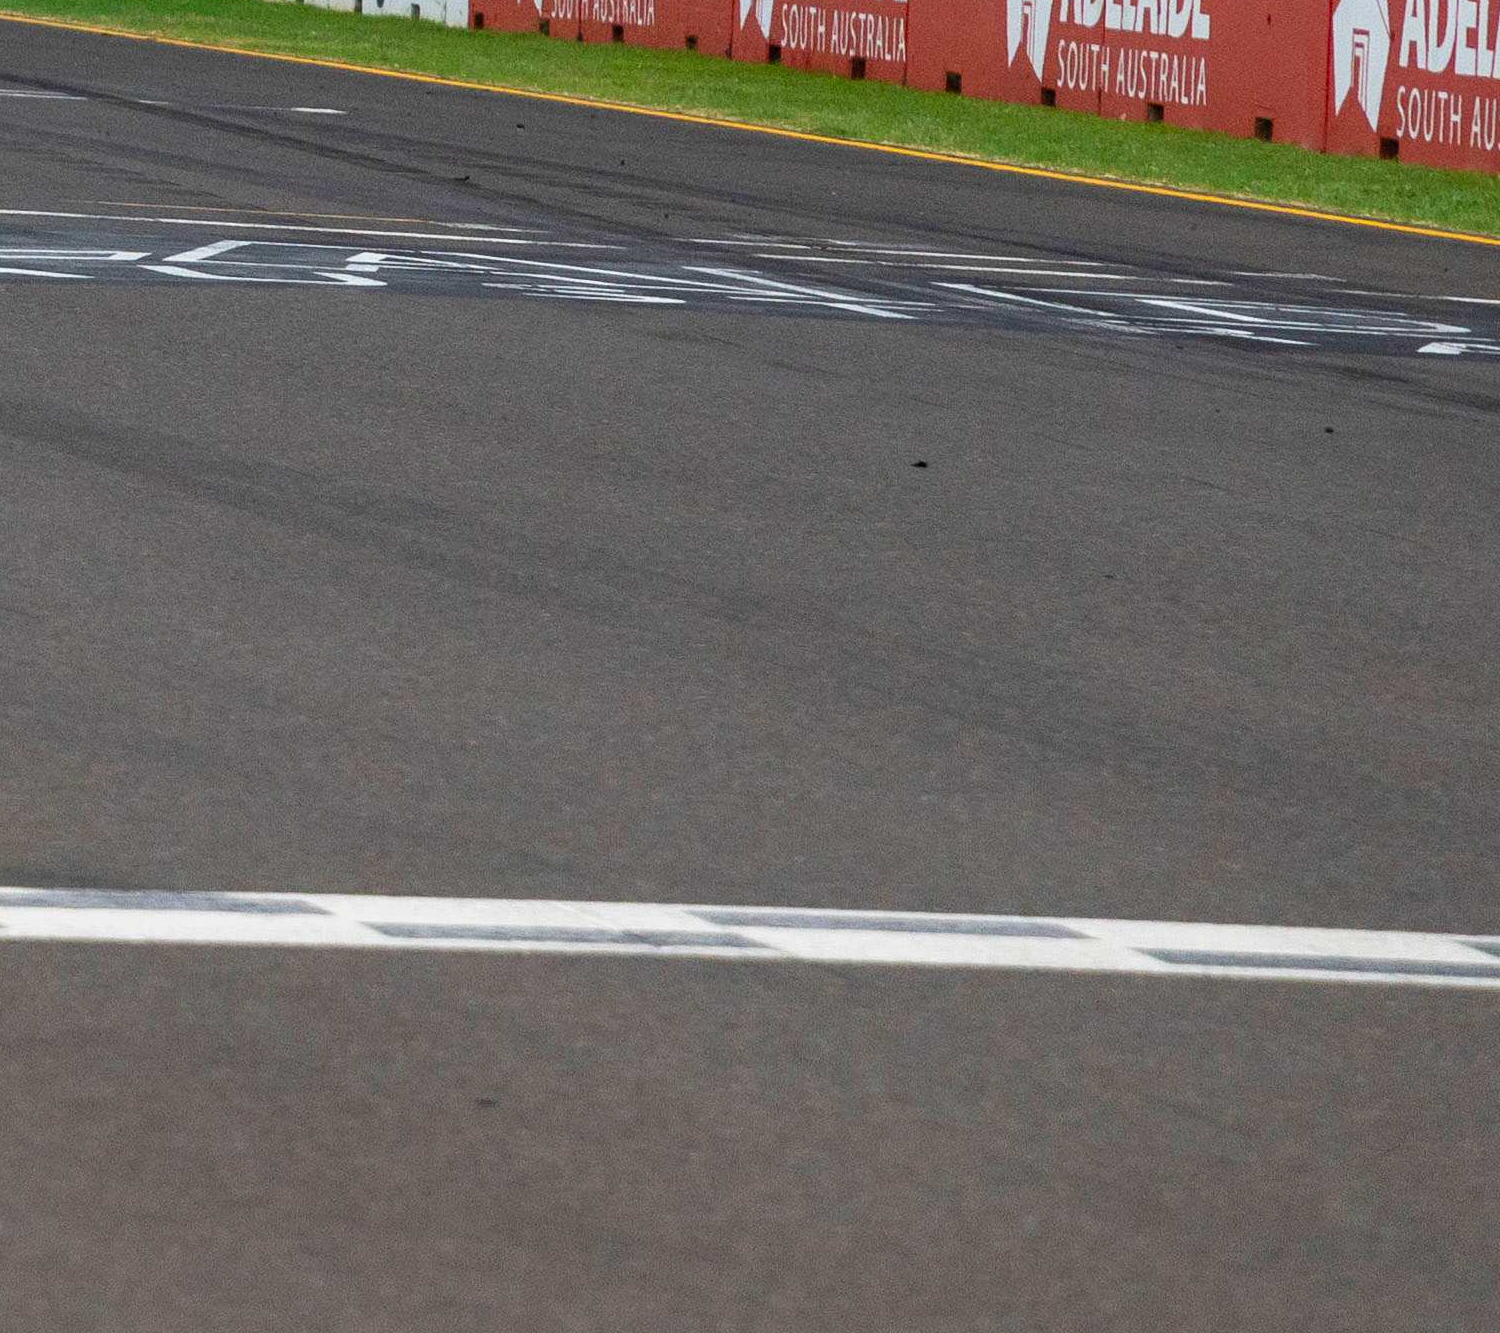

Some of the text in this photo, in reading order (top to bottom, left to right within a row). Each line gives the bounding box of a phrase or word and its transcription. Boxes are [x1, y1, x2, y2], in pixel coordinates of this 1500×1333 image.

[781, 3, 907, 62] SOUTH AUSTRALIA
[1056, 39, 1207, 106] SOUTH AUSTRALIA
[1396, 85, 1500, 153] SOUTH AU
